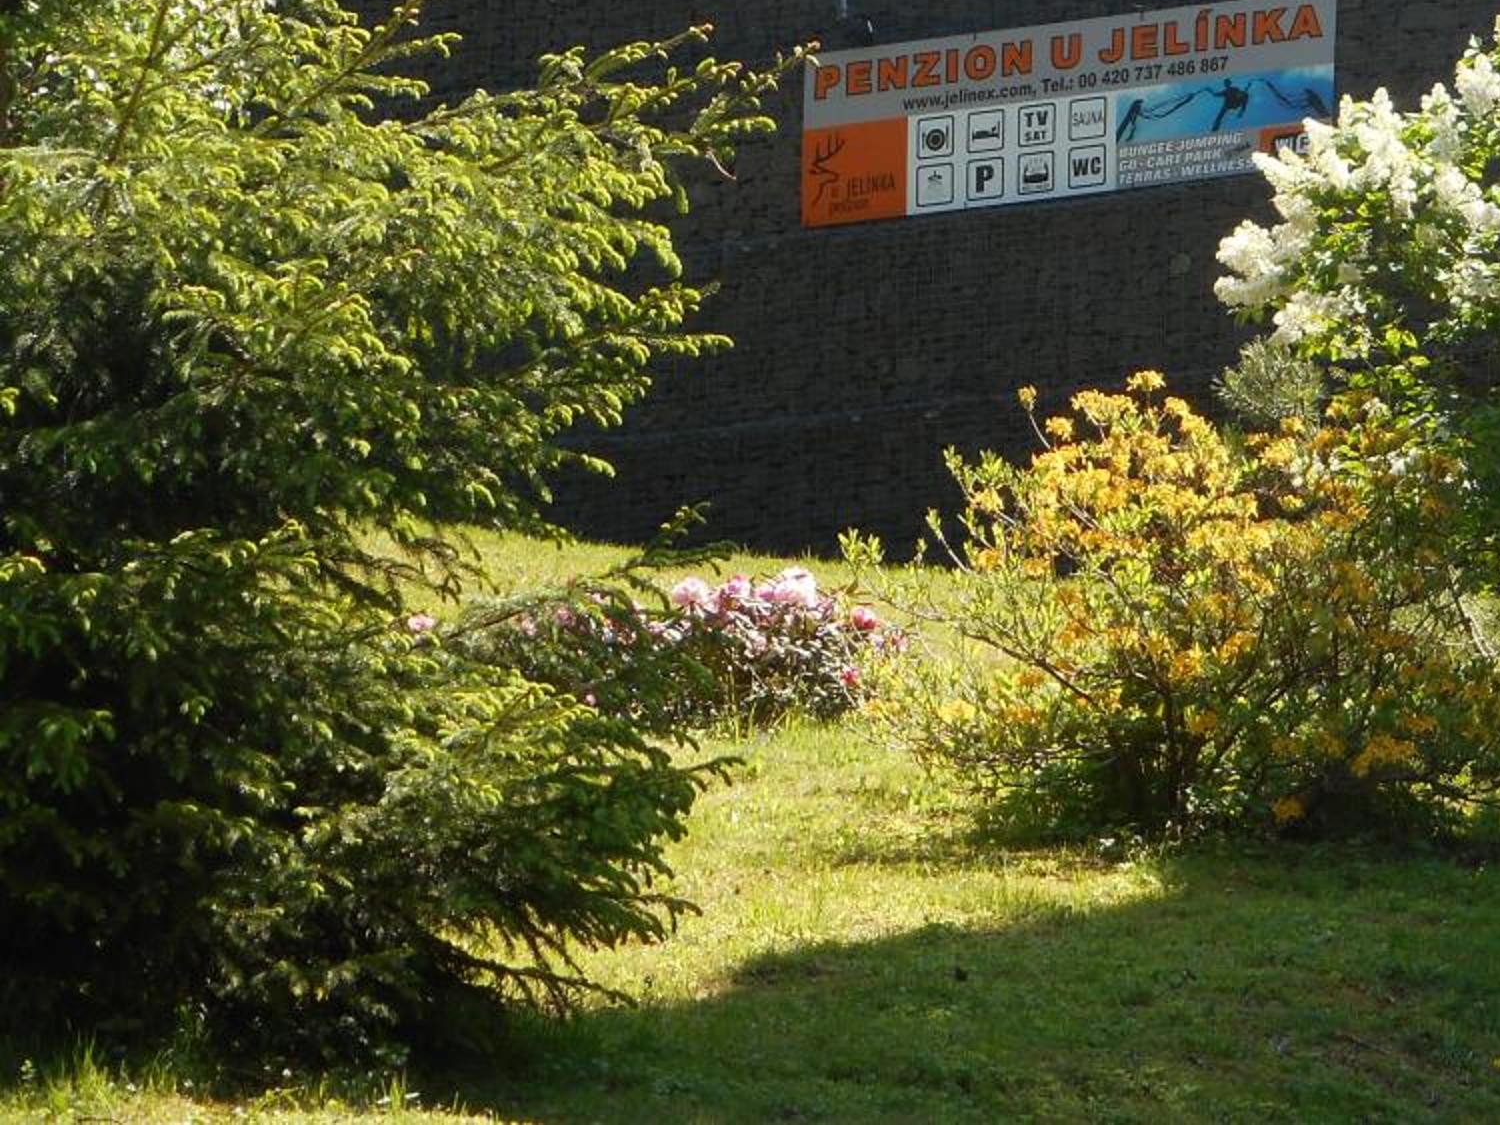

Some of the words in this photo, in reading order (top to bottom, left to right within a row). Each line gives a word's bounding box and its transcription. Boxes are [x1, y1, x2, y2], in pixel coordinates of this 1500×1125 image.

[813, 40, 1033, 101] PENZION
[1050, 33, 1082, 70] U
[1098, 4, 1323, 64] JELÍNKA
[1078, 72, 1097, 88] 00
[1101, 68, 1129, 85] 420
[1135, 63, 1163, 81] 737
[1167, 59, 1196, 77] 486
[1023, 109, 1049, 128] TV
[1024, 130, 1047, 142] SAT
[975, 164, 995, 194] P
[1072, 156, 1102, 178] WC
